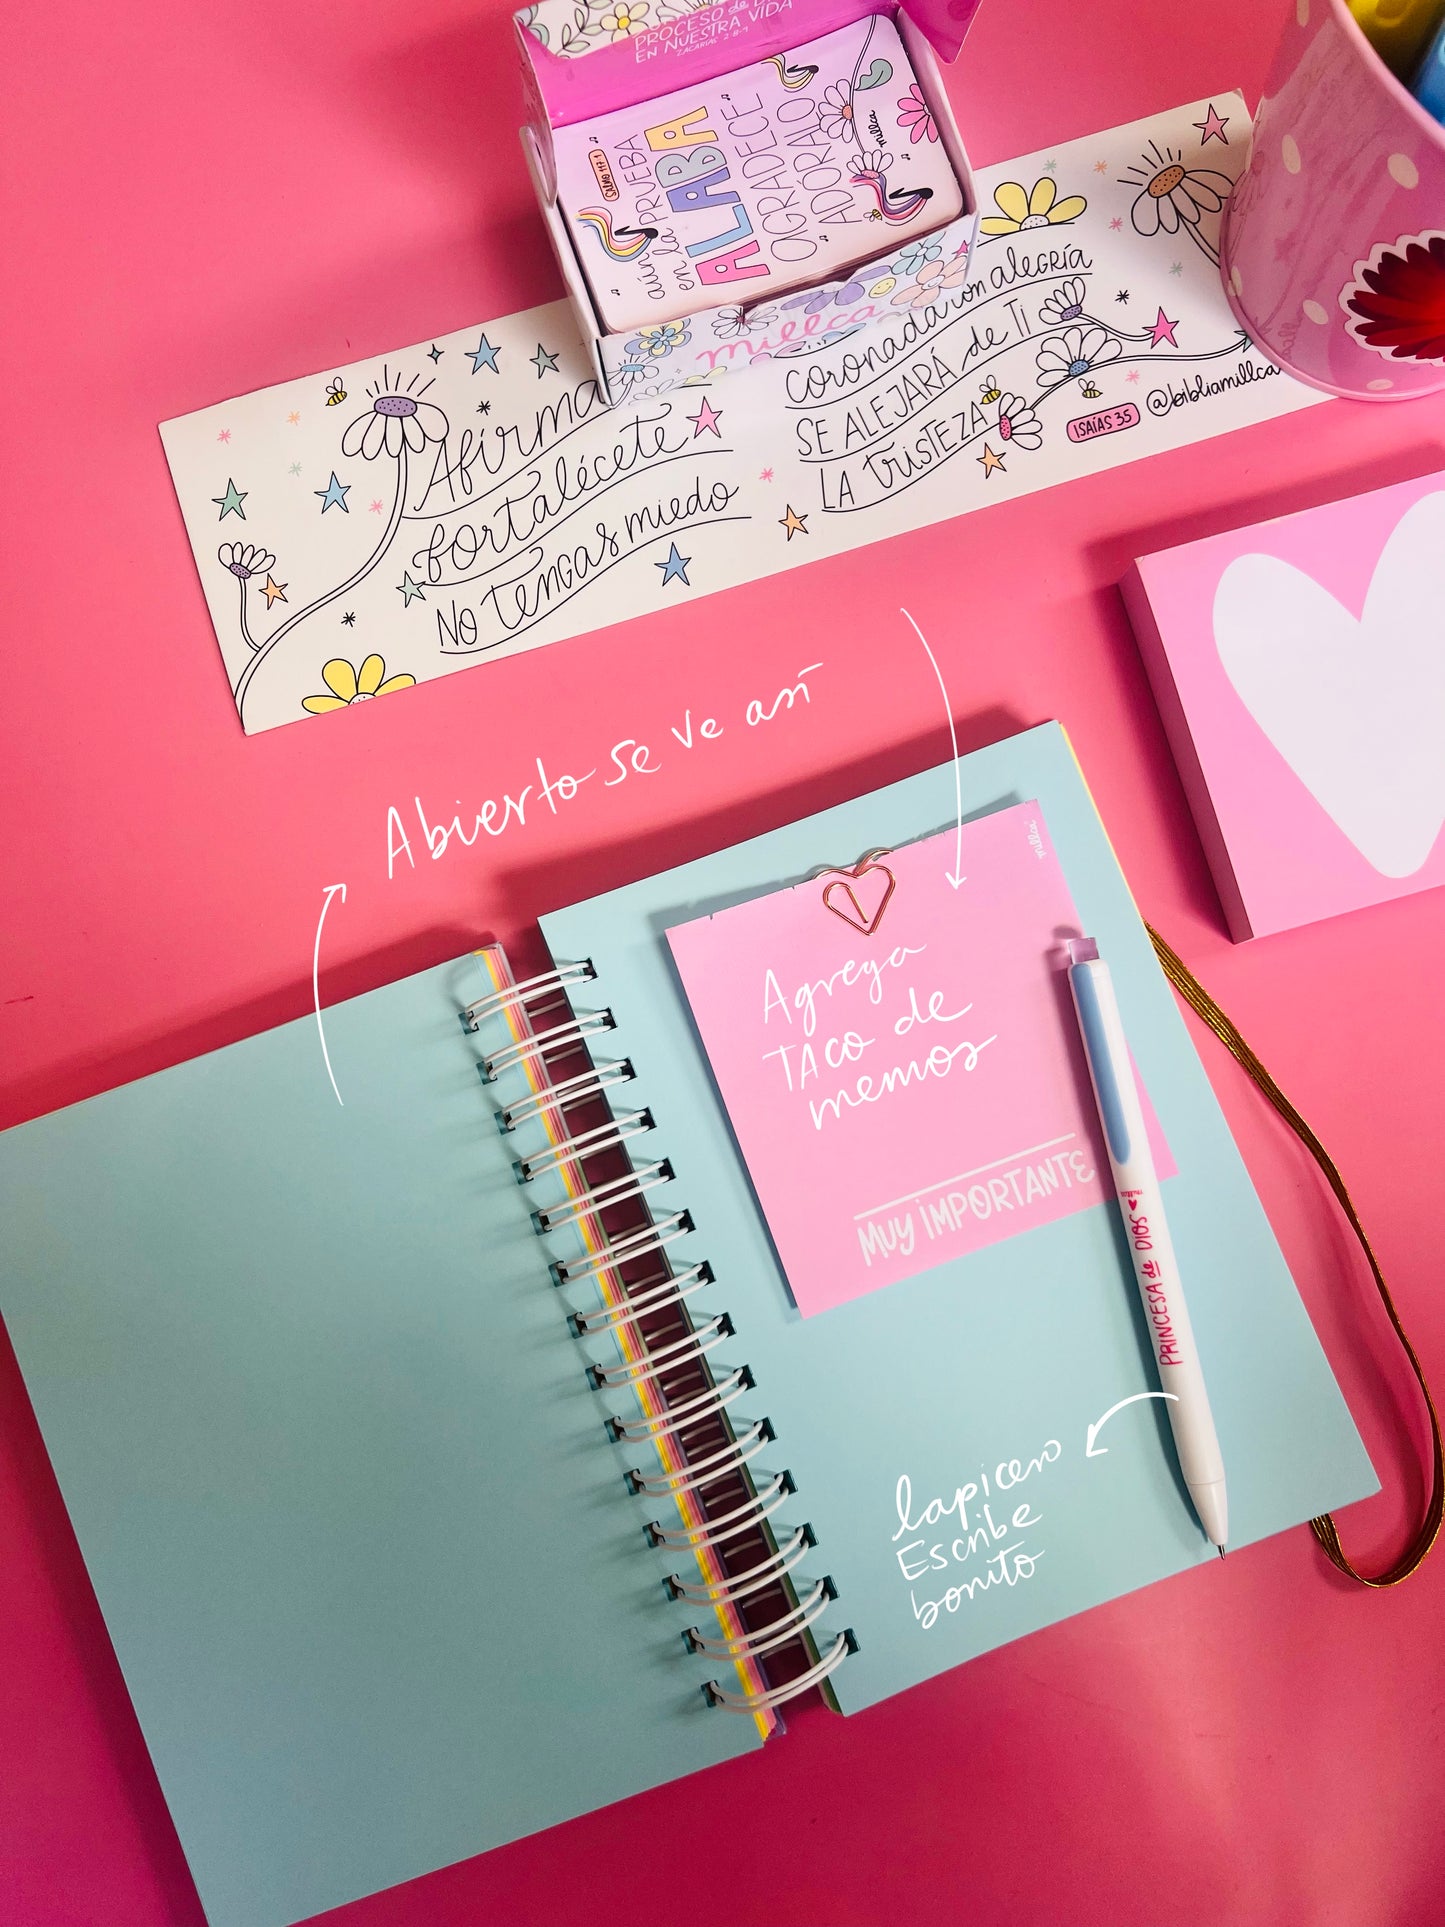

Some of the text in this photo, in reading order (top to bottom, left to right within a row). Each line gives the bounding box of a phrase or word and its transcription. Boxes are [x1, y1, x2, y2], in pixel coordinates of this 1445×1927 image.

[634, 7, 724, 51] PROCESO
[635, 49, 657, 64] EN
[664, 15, 741, 53] NUESTRA
[748, 0, 793, 22] VIDA
[613, 134, 695, 291] en la PRUEBA
[644, 106, 771, 286] ALABA
[796, 417, 833, 455] SE
[845, 346, 958, 449] ALEJARÁ
[961, 325, 1009, 371] de
[1146, 360, 1282, 416] @bibliamillca
[1073, 409, 1132, 438] ISAÍAS 35
[625, 476, 740, 543] miedo
[820, 468, 855, 509] LA
[857, 1149, 1096, 1267] MUY IMPORTANTE
[1129, 1214, 1184, 1366] PRINCESA de DIOS
